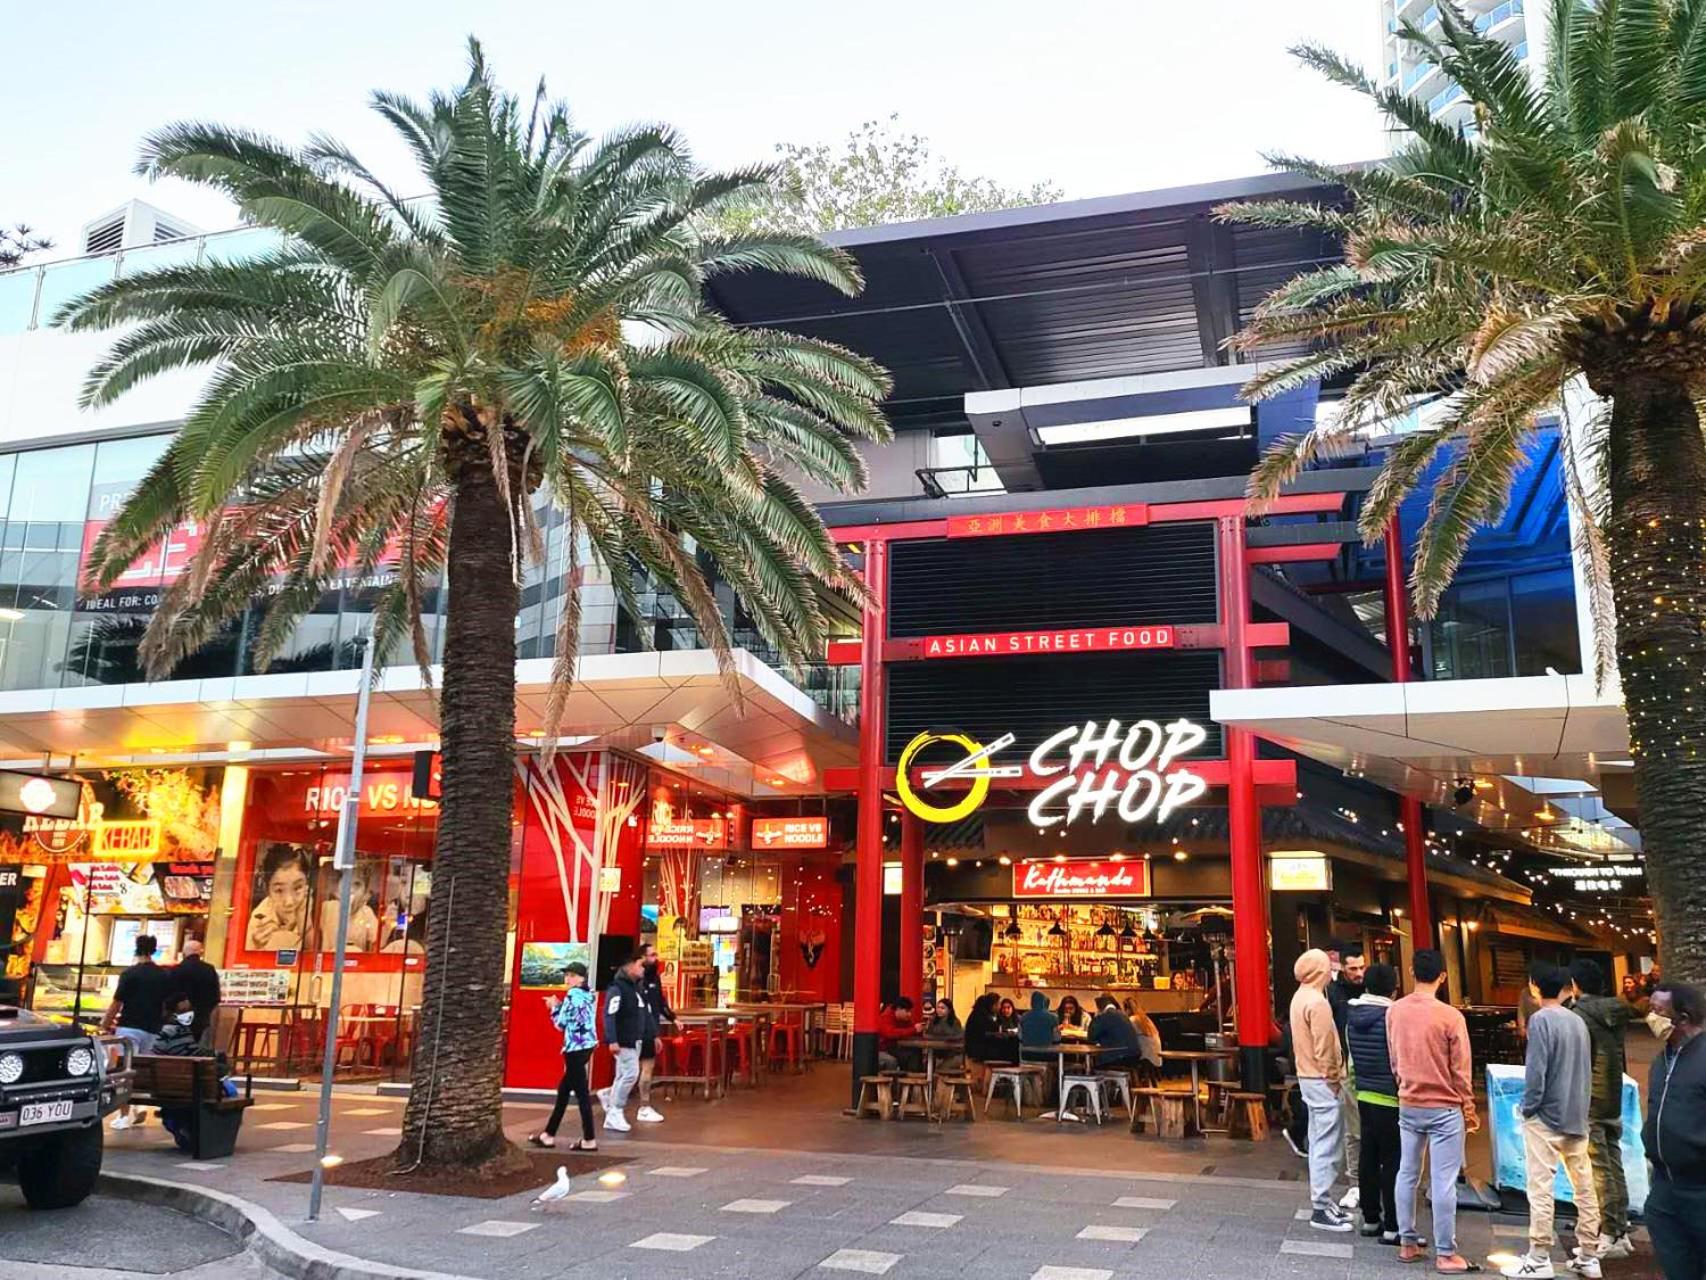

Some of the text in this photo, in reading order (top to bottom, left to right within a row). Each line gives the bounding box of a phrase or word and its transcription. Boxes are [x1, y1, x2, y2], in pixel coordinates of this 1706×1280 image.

[85, 598, 116, 611] IDEAL
[118, 595, 141, 608] FOR:
[929, 629, 1169, 653] ASIAN STREET FOOD
[1029, 718, 1207, 776] CHOP
[304, 785, 352, 812] RIC
[367, 783, 398, 810] VS
[1027, 769, 1207, 828] CHOP
[101, 826, 153, 851] KEBAB
[784, 824, 807, 832] RICE
[784, 834, 823, 843] NOODLE
[1023, 864, 1133, 892] Kathmandu
[22, 1107, 43, 1121] 036
[48, 1103, 71, 1118] YOU
